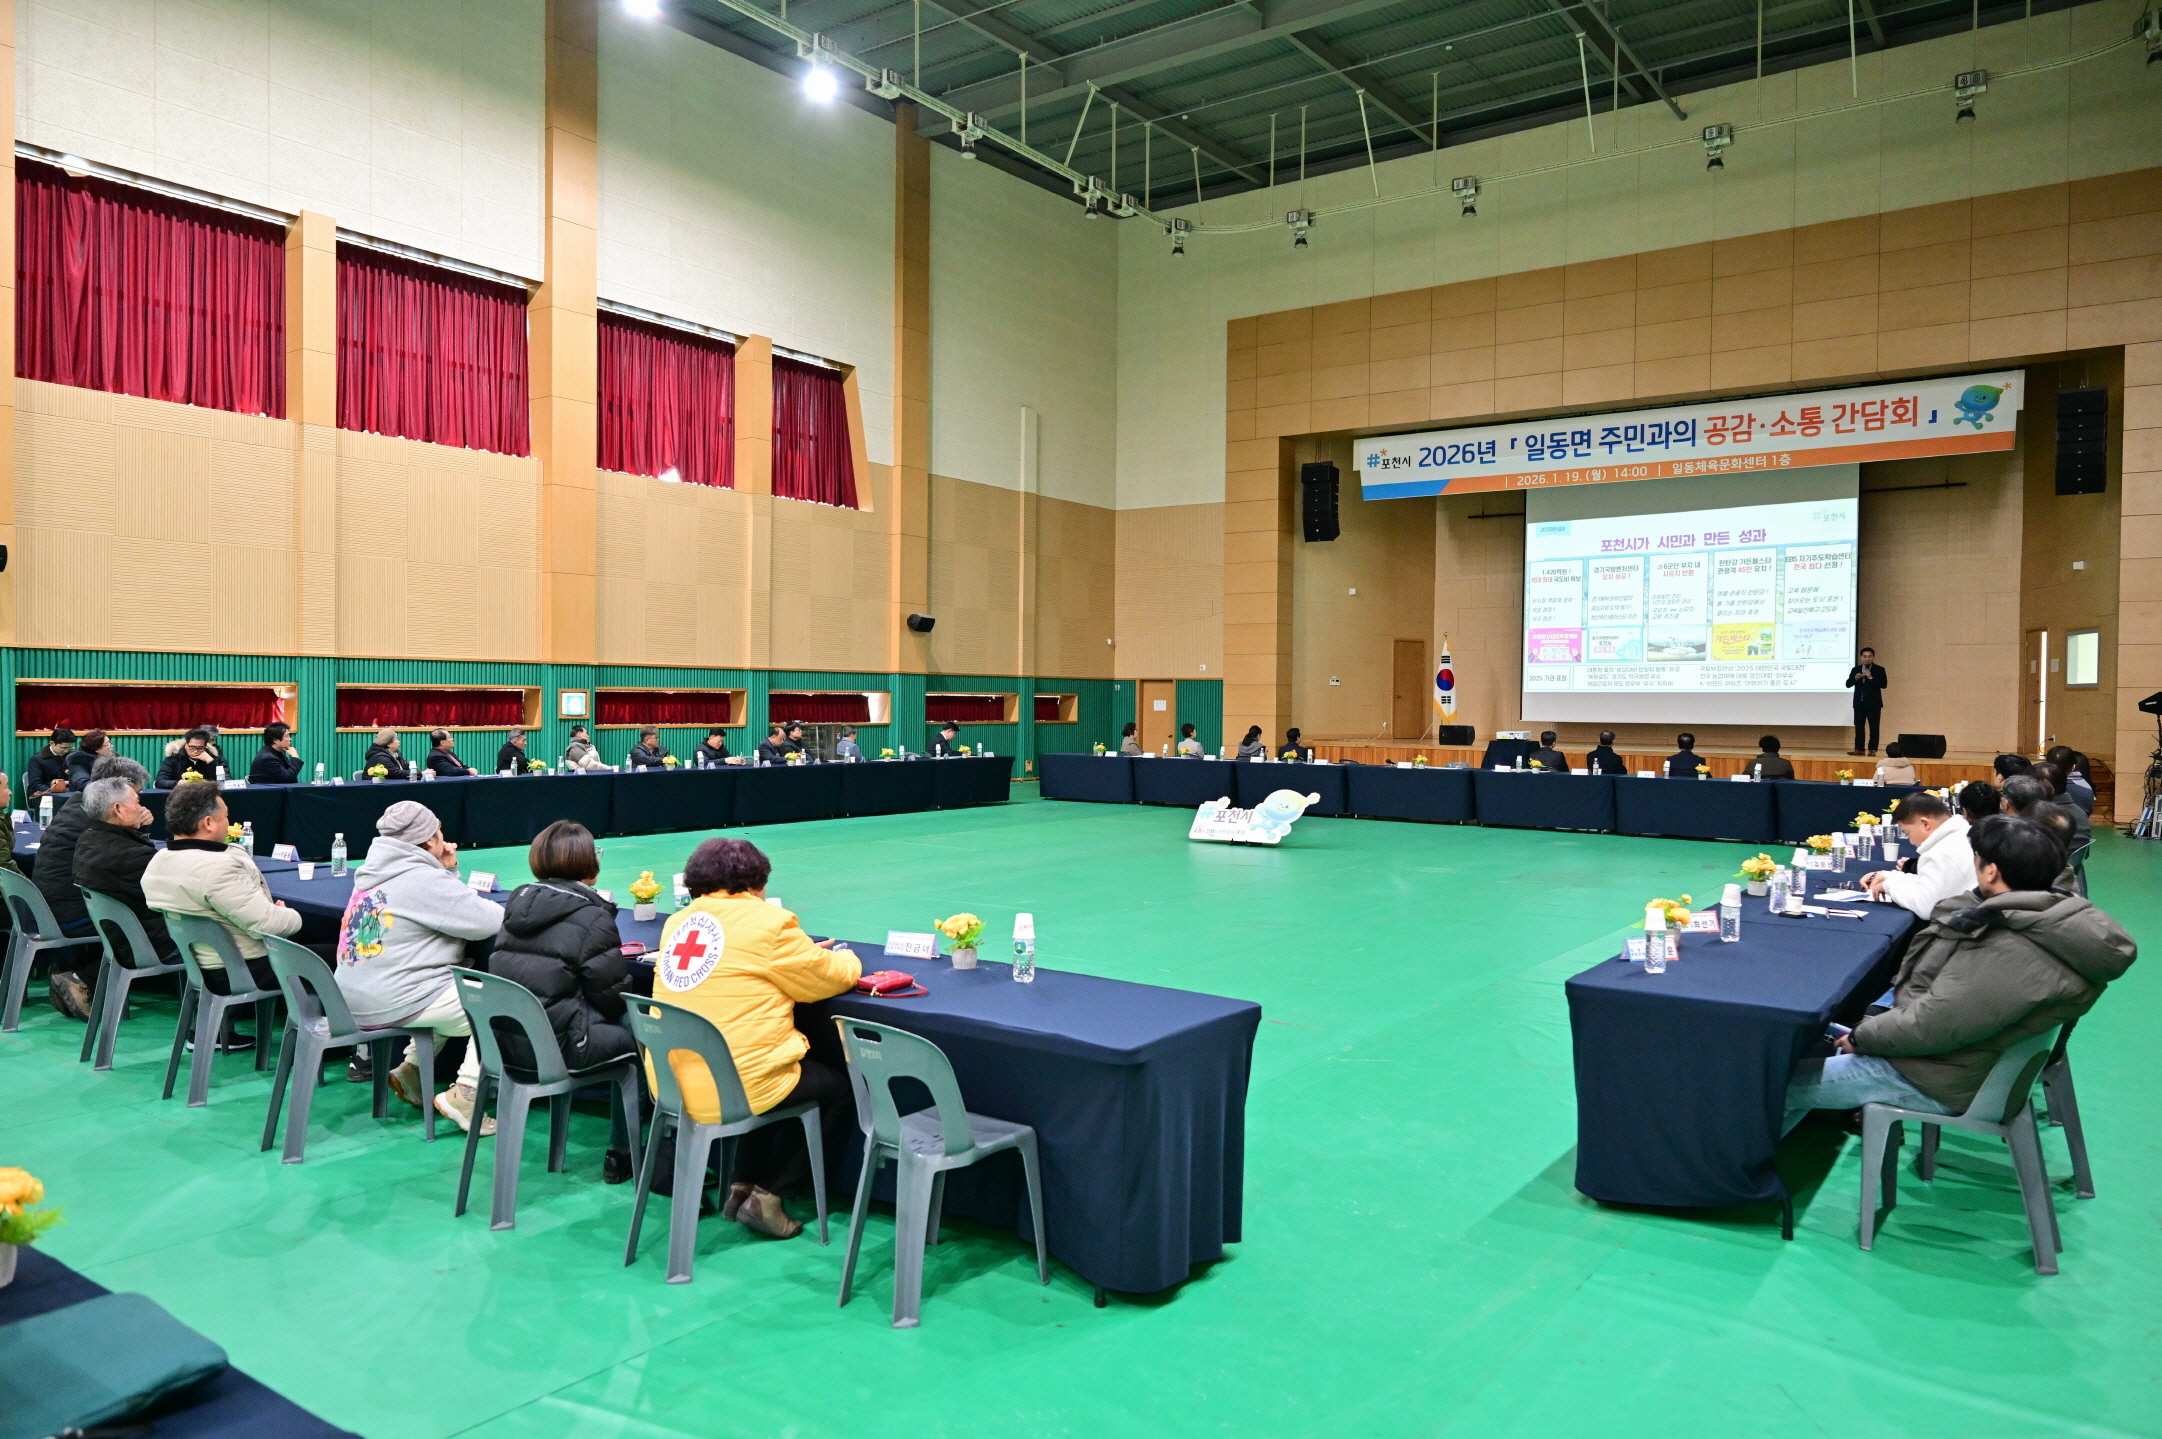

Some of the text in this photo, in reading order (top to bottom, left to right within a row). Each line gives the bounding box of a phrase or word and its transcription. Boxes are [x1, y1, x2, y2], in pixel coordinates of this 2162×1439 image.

[1418, 440, 1497, 468] 2026년
[1598, 418, 1698, 454] 주민과의
[1516, 474, 1550, 487] 2026.
[1585, 468, 1608, 482] (월)
[1613, 466, 1648, 479] 14:00
[1671, 455, 1768, 476] 일동체육문화센터
[1771, 453, 1792, 468] 1층
[1601, 529, 1766, 552] 포천시가 시민과 만든 성과
[1739, 557, 1772, 565] 가든페스타
[1799, 553, 1851, 562] 자기주도학습센터
[1593, 565, 1639, 574] 경기국방벤처센터
[1717, 566, 1736, 574] 관광객
[1793, 563, 1807, 571] 전국
[1824, 561, 1838, 569] 선정
[1554, 575, 1569, 583] 국도비
[1529, 674, 1543, 682] 2025
[1545, 674, 1556, 682] 기관
[905, 942, 930, 954] 진금녀
[663, 950, 719, 988] KOREAN RED CROSS
